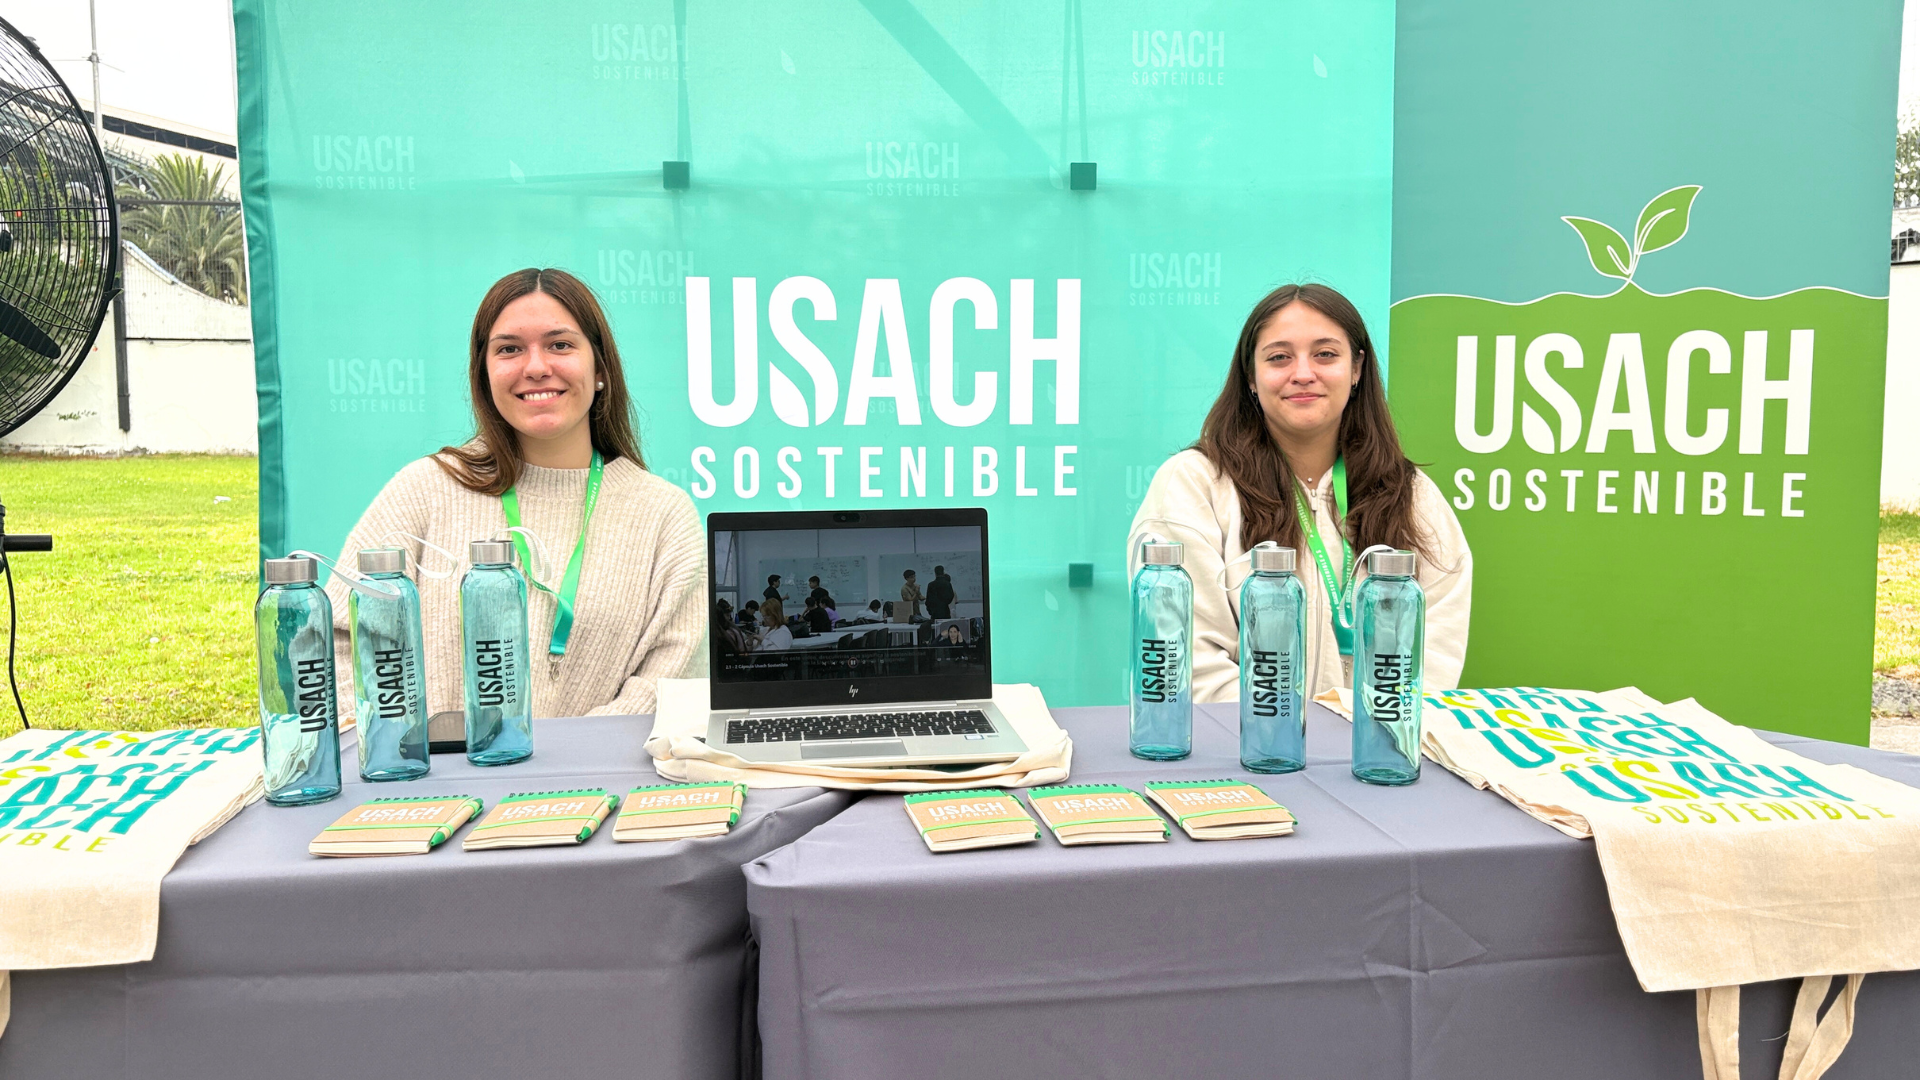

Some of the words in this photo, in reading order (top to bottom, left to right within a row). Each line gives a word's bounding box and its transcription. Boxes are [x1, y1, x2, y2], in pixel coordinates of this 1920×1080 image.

[591, 24, 688, 62] USACH
[1132, 30, 1225, 68] USACH
[1132, 71, 1225, 87] SOSTENIBLE
[313, 135, 415, 173] USACH
[865, 142, 960, 179] USACH
[315, 175, 416, 190] SOSTENIBLE
[866, 182, 960, 197] SOSTENIBLE
[597, 249, 695, 287] USACH
[1129, 252, 1222, 289] USACH
[1129, 292, 1221, 306] SOSTENIBLE
[685, 276, 1082, 428] USACH
[327, 358, 426, 395] USACH
[1454, 329, 1815, 456] USACH
[690, 445, 1079, 500] SOSTENIBLE
[1453, 468, 1807, 518] SOSTENIBLE
[375, 648, 407, 719] USACH
[405, 646, 418, 715] SOSTENIBLE
[475, 638, 505, 708] USACH
[503, 637, 517, 704] SOSTENIBLE
[1142, 638, 1166, 703] USACH
[1168, 639, 1178, 703] SOSTENIBLE
[1253, 650, 1278, 718] USACH
[1280, 651, 1290, 717] SOSTENIBLE
[1373, 653, 1401, 723] USACH
[1403, 653, 1413, 722] SOSTENIBLE
[297, 657, 328, 734] USACH
[327, 657, 336, 728] SOSTENIBLE
[848, 684, 859, 698] hp
[1478, 725, 1743, 770] USACH
[640, 791, 720, 805] USACH
[1173, 790, 1252, 802] USACH
[1560, 758, 1856, 804] USACH
[358, 806, 446, 819] USACH
[502, 801, 586, 816] USACH
[928, 802, 1007, 817] USACH
[1052, 797, 1131, 810] USACH
[1631, 799, 1896, 824] SOSTENIBLE
